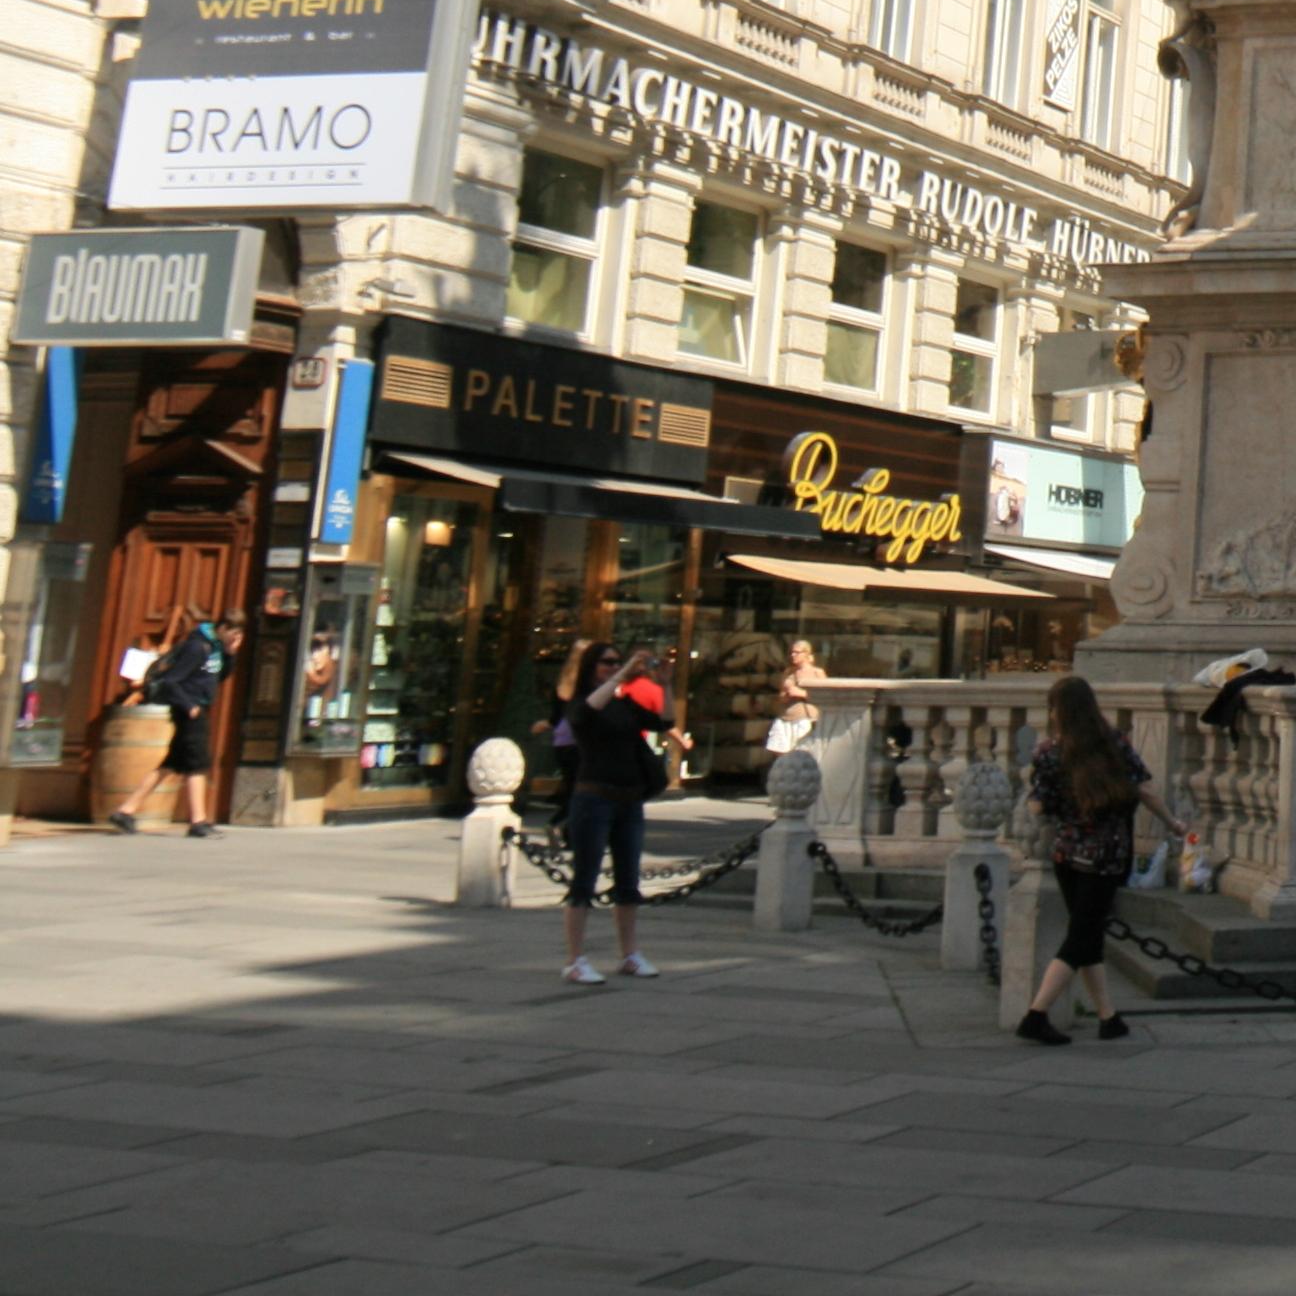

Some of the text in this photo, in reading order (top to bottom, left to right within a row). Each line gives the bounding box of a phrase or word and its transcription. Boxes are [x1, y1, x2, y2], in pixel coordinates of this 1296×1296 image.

[1045, 29, 1079, 91] PELZE
[165, 103, 373, 154] BRAMO
[463, 369, 656, 439] PALETTE
[789, 431, 963, 564] Buchegger
